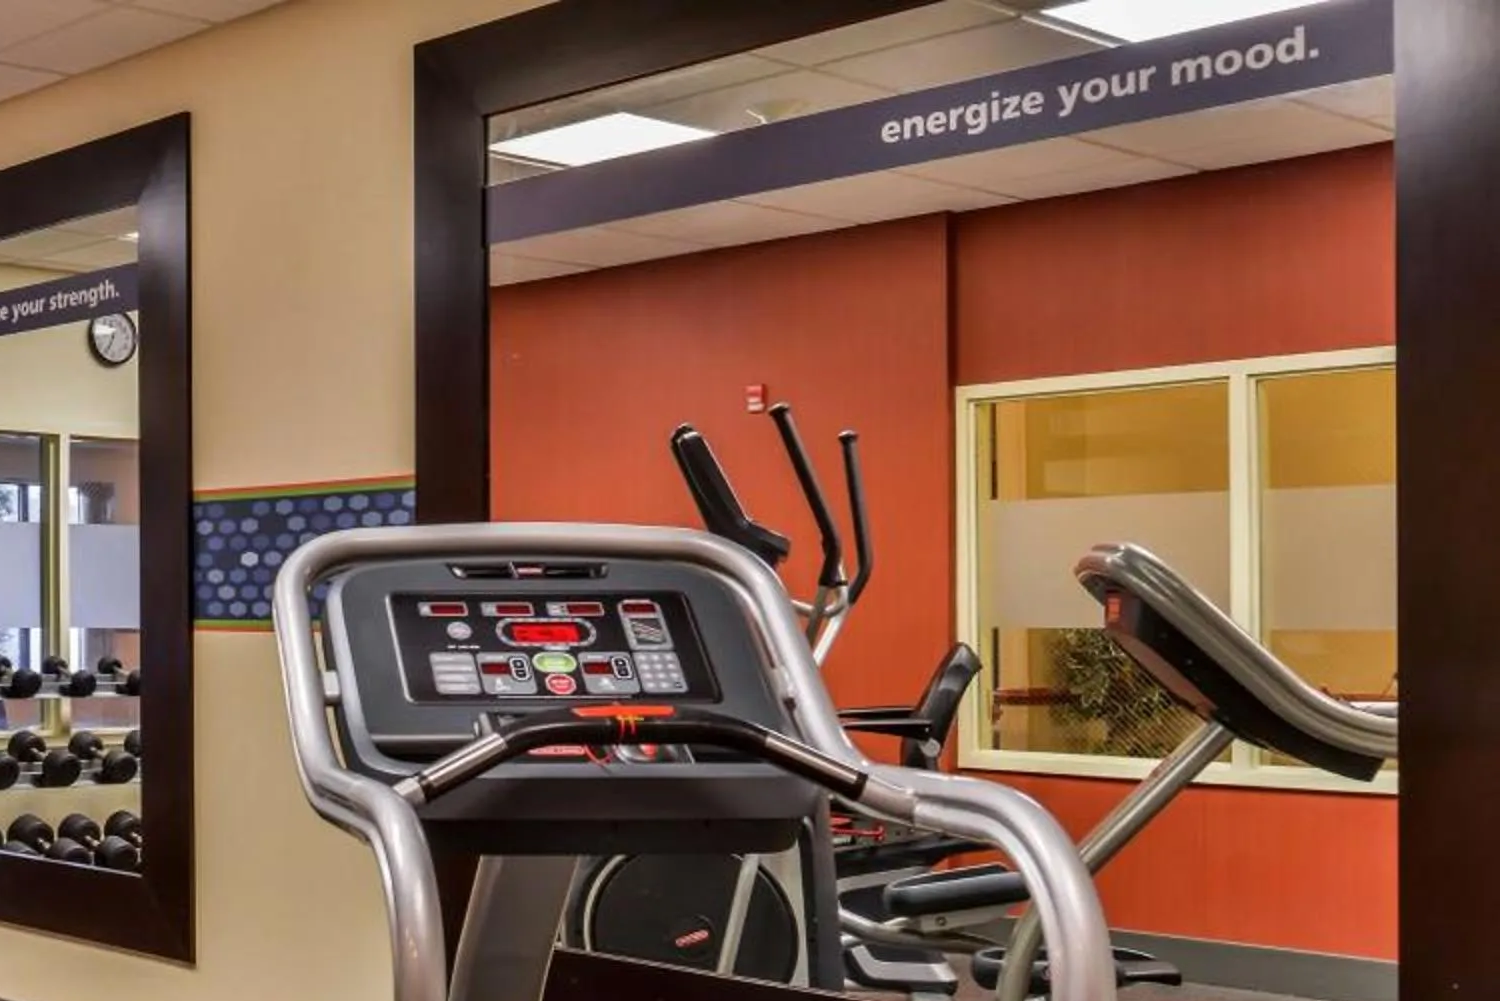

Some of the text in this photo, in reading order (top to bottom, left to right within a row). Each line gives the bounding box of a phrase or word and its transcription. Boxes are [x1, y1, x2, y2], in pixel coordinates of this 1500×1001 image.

[880, 25, 1321, 144] energize your mood.
[11, 297, 45, 323] your
[49, 279, 120, 308] strength.
